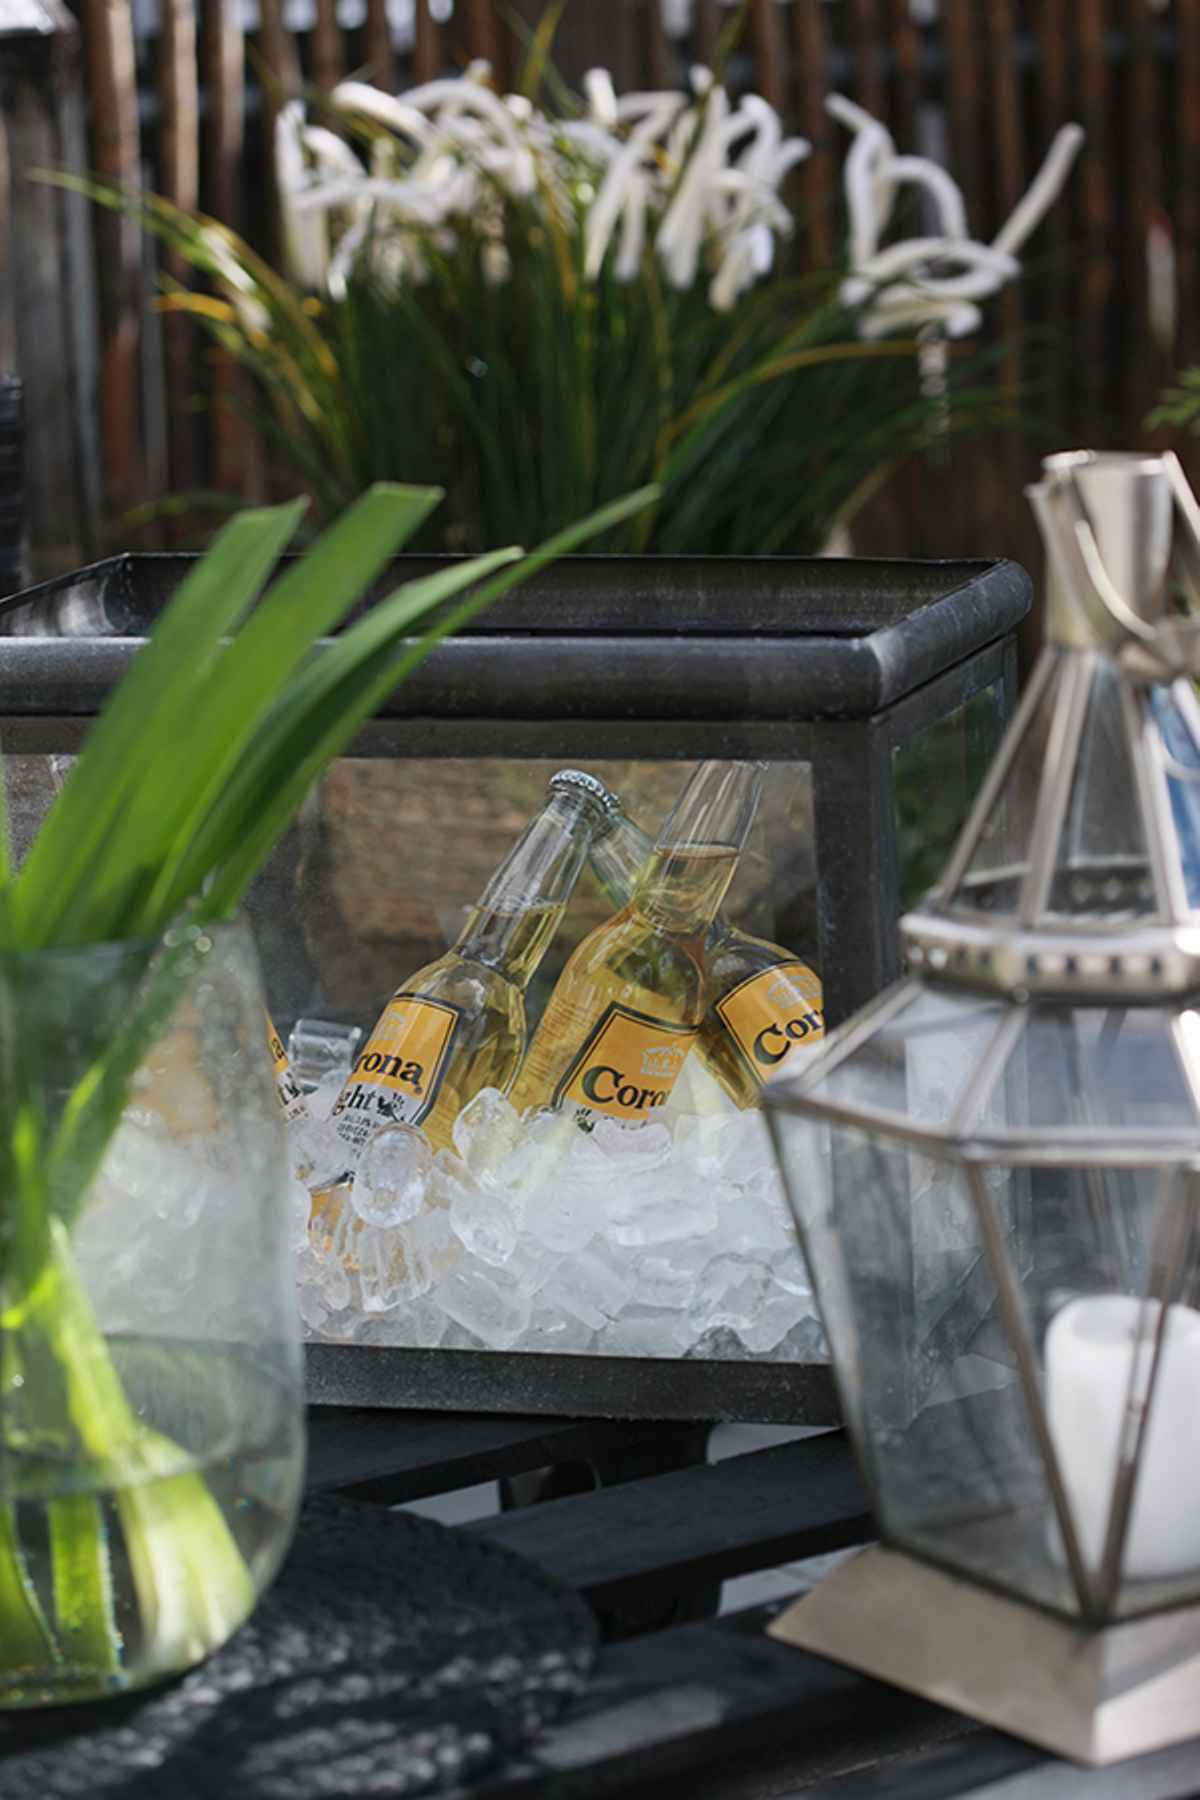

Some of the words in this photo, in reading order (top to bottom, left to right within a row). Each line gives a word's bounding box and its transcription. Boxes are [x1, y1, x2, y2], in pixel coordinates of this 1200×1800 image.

[754, 1010, 824, 1065] Cor
[352, 1052, 423, 1085] rona
[582, 1065, 671, 1109] Coro
[332, 1084, 377, 1116] ght
